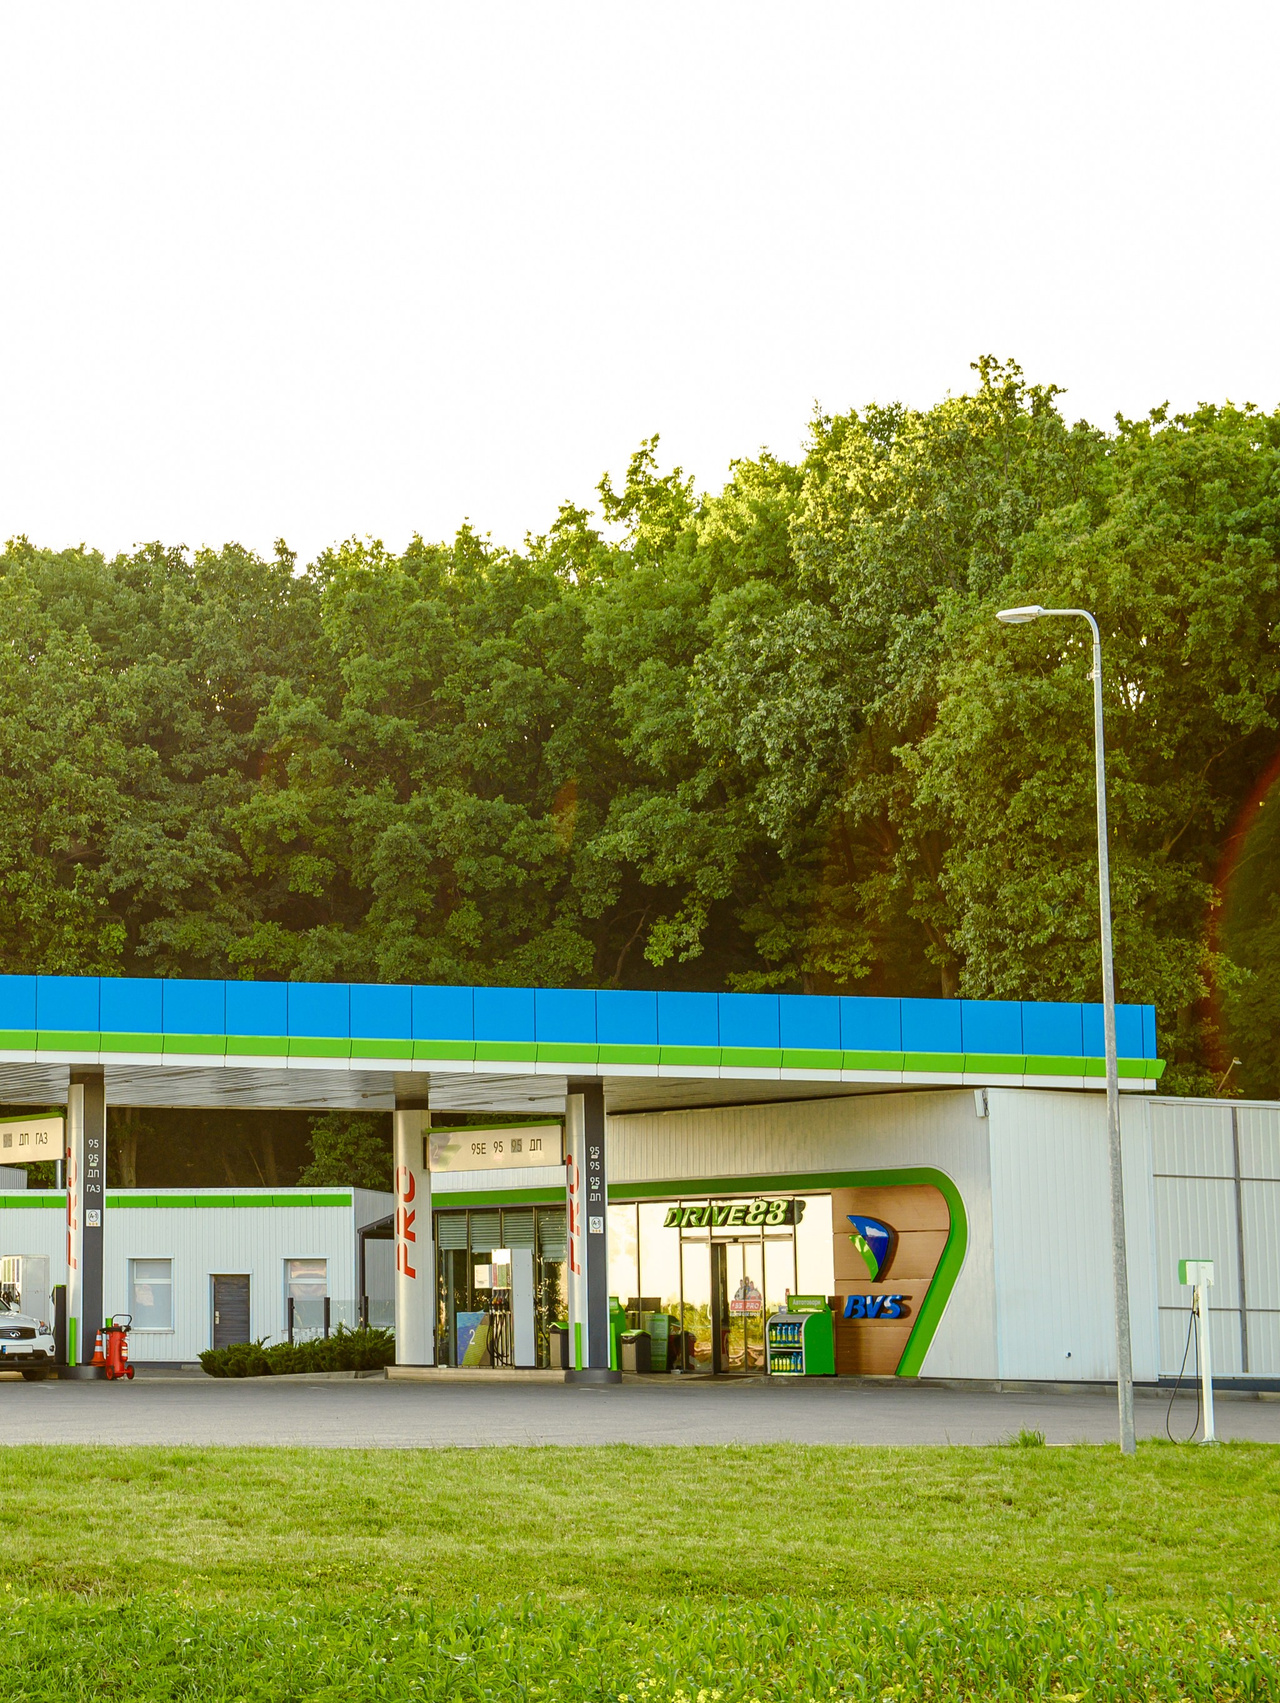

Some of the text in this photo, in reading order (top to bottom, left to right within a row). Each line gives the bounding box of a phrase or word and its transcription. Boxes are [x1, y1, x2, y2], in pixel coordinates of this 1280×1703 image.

[19, 1133, 29, 1146] ДП
[35, 1132, 48, 1145] ГАЗ
[88, 1139, 99, 1148] 95
[493, 1141, 503, 1153] 95
[529, 1139, 542, 1152] ДП
[588, 1146, 600, 1155] 95
[88, 1154, 99, 1163] 95
[589, 1161, 600, 1170] 95
[87, 1169, 100, 1178] ДП
[589, 1176, 600, 1186] 95
[86, 1184, 101, 1193] ГАЗ
[589, 1193, 601, 1201] ДП
[843, 1295, 903, 1319] BVS
[469, 1329, 475, 1345] 2
